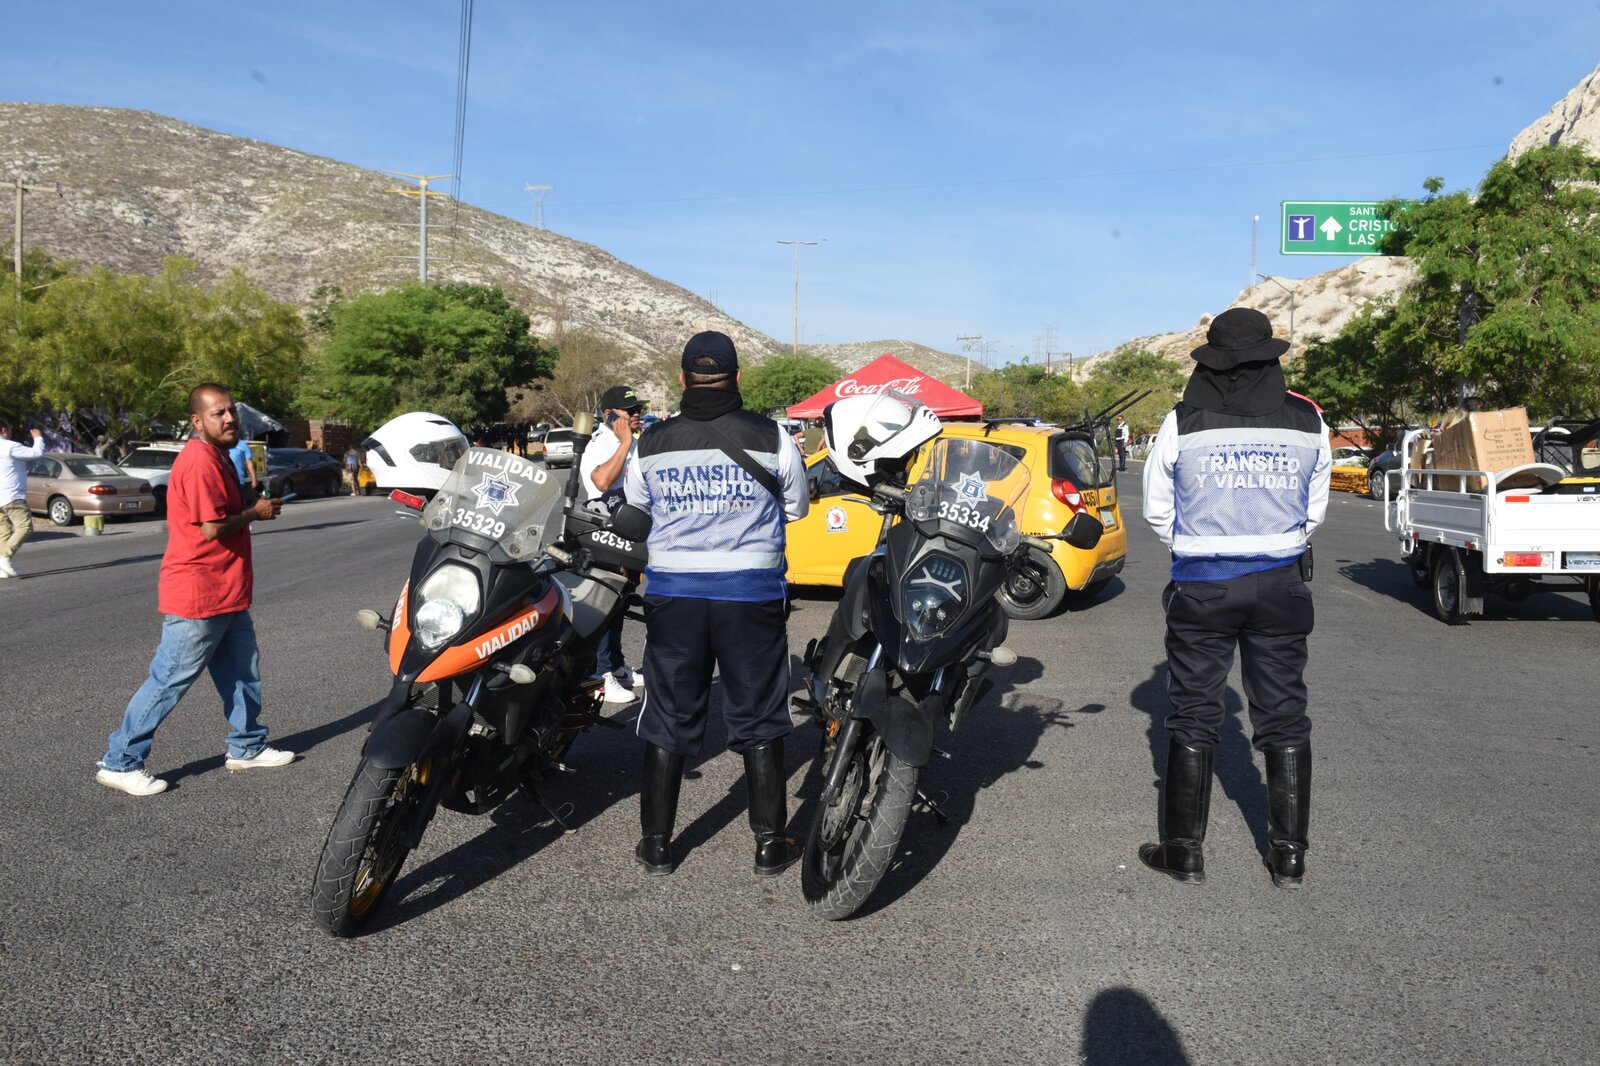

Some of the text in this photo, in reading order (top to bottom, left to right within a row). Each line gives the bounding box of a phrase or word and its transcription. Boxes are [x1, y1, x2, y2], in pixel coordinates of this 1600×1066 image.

[1348, 233, 1376, 245] LAS
[467, 450, 548, 485] VIALIDAD
[1196, 473, 1299, 490] Y VIALIDAD
[452, 507, 506, 538] 35329
[937, 500, 991, 533] 35334
[474, 611, 540, 660] VIALIDAD
